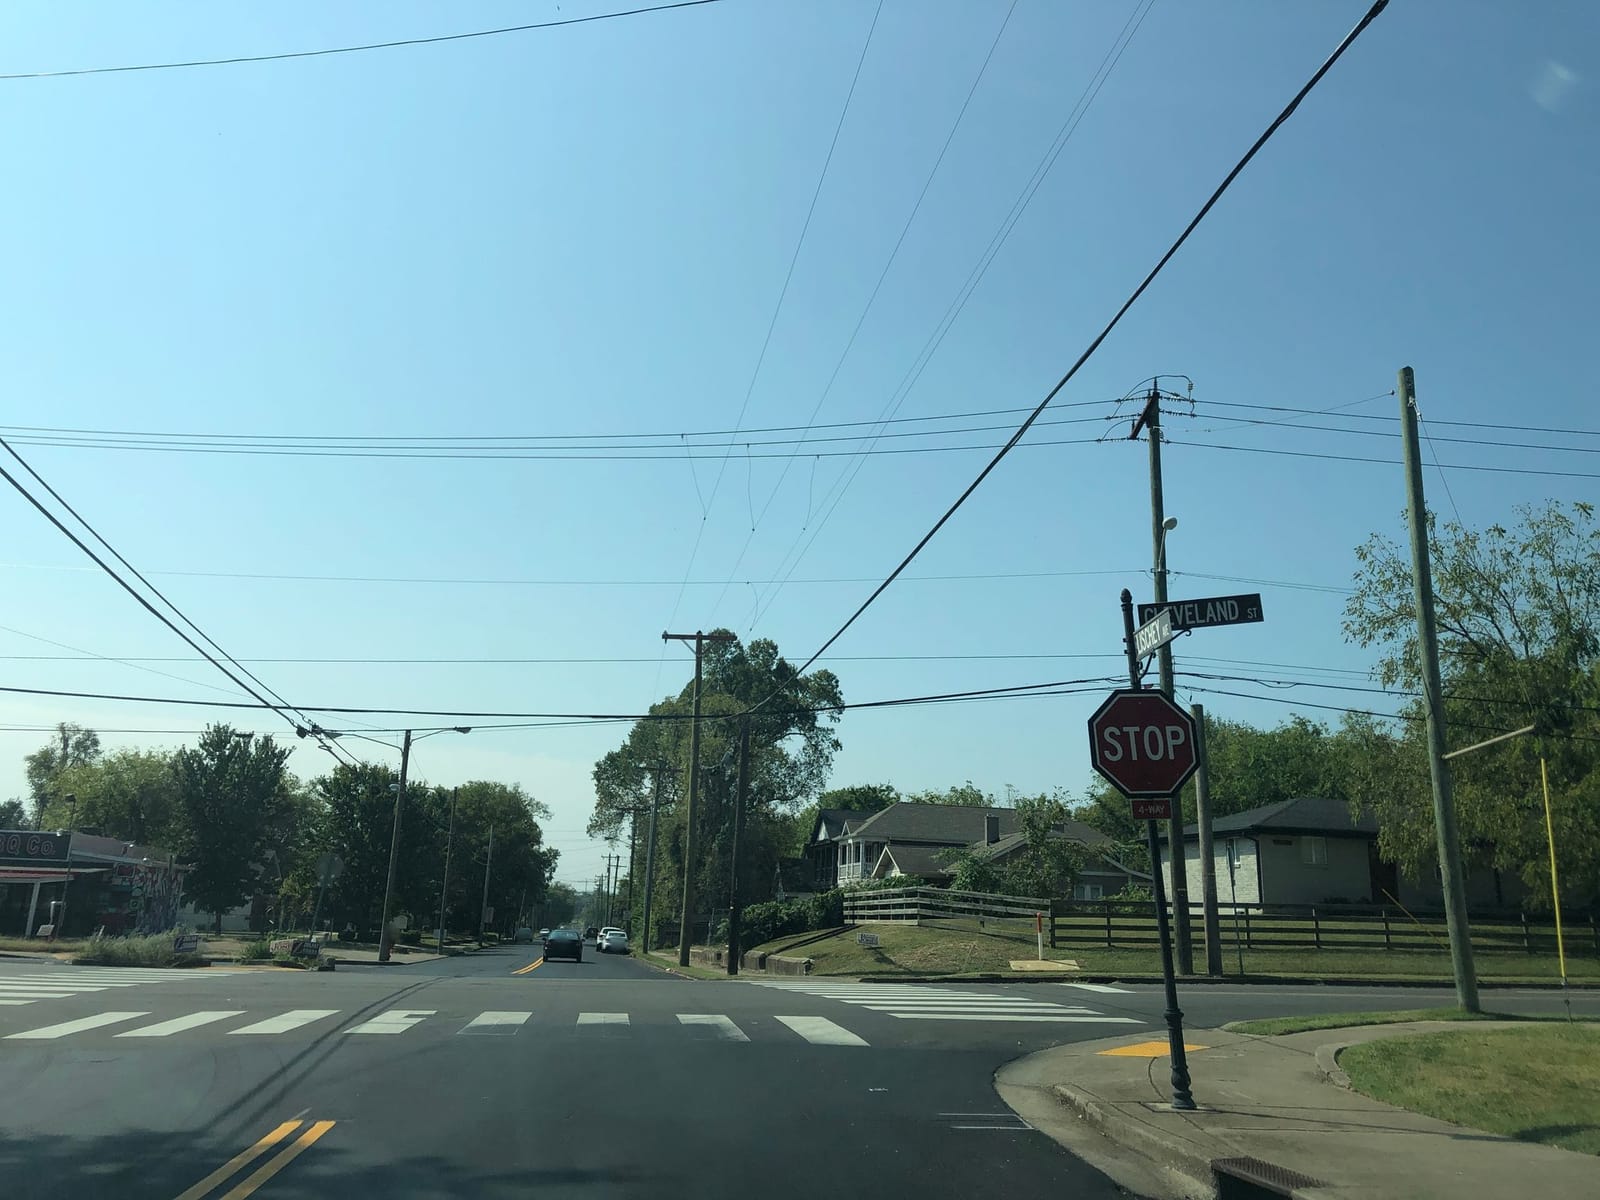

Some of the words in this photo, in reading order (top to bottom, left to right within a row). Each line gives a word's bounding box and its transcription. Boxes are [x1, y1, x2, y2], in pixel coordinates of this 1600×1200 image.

[1247, 607, 1258, 619] ST
[1135, 618, 1160, 654] LISCHEY
[1103, 725, 1185, 762] STOP
[1138, 804, 1165, 815] 4-WAY
